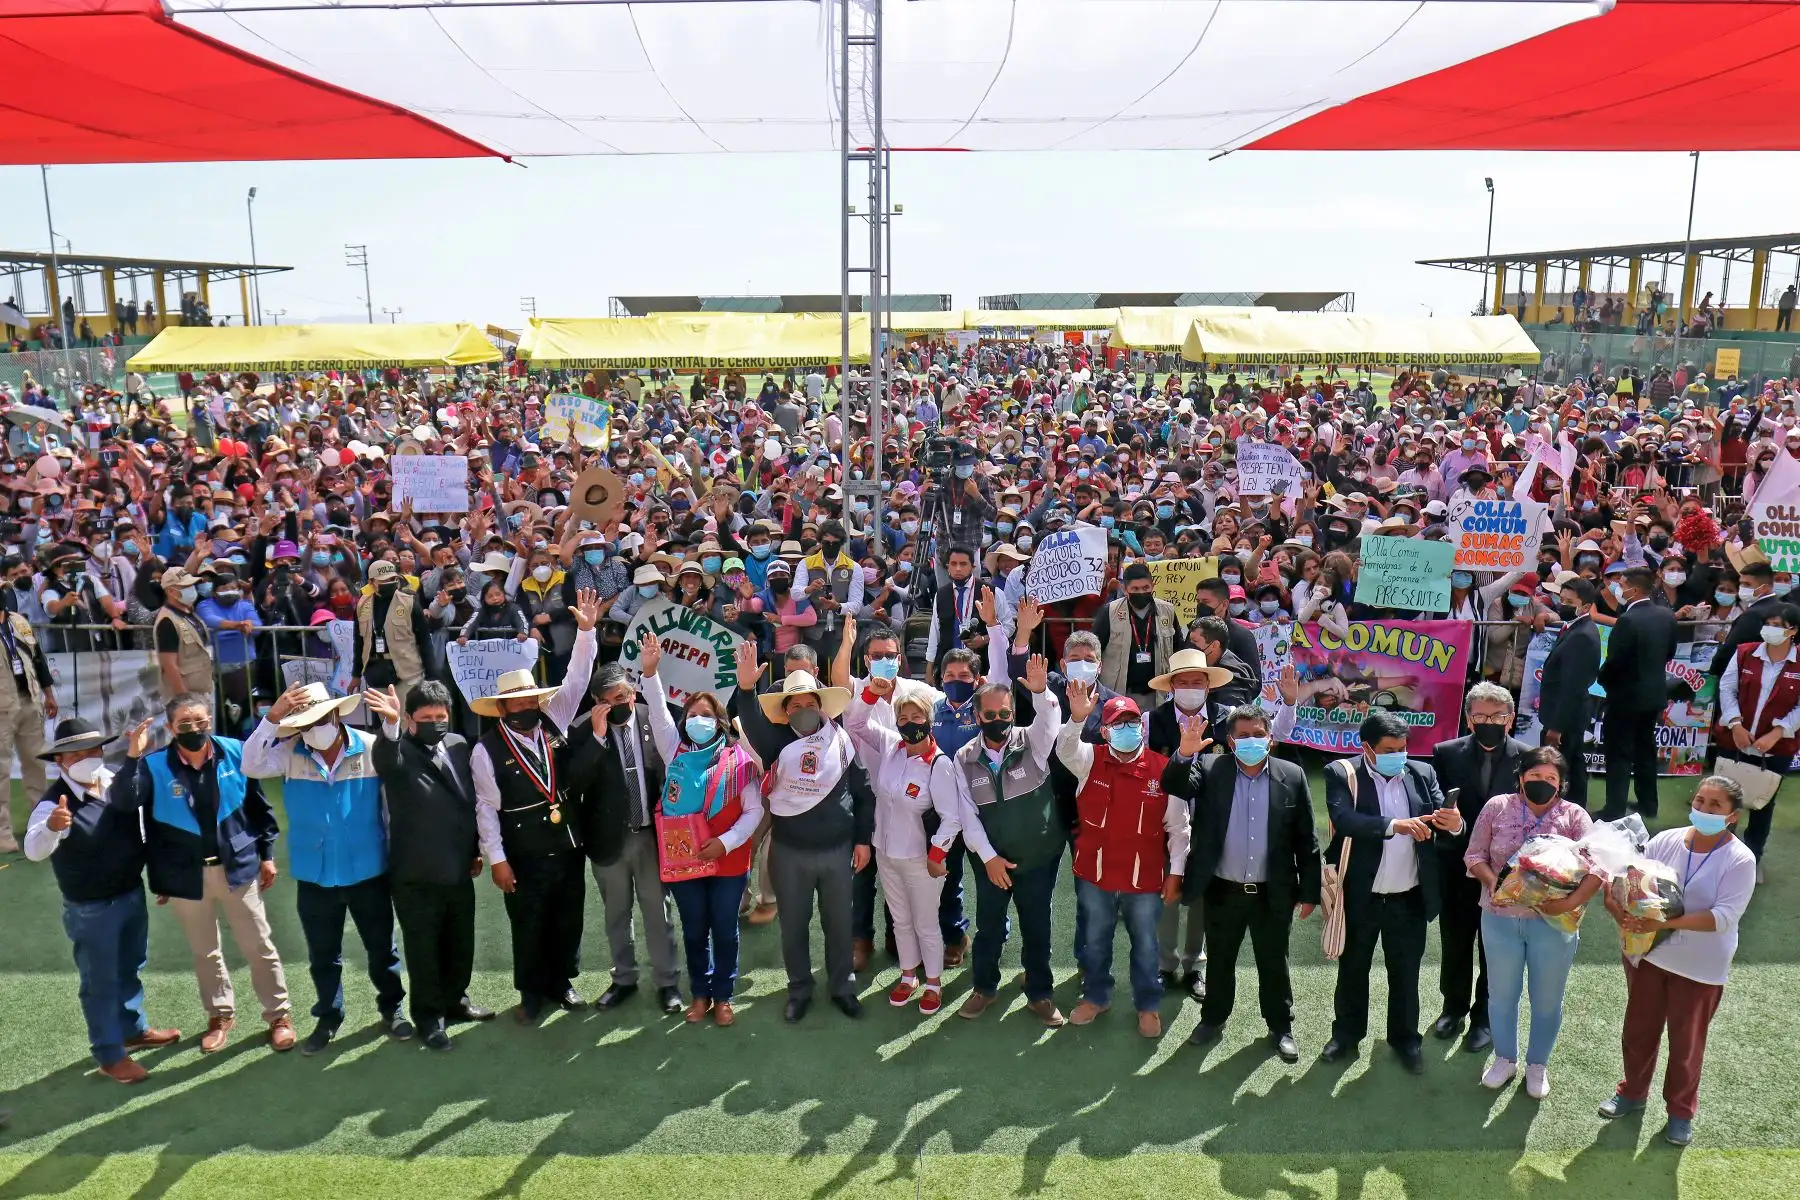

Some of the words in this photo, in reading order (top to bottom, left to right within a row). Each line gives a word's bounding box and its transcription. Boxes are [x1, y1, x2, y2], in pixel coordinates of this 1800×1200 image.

[150, 363, 231, 373] MUNICIPALIDAD
[234, 361, 288, 372] DISTRITAL
[291, 360, 305, 371] DE
[307, 360, 343, 371] CERRO
[346, 359, 405, 370] COLORADO
[560, 357, 646, 369] MUNICIPALIDAD
[649, 356, 707, 368] DISTRITAL
[710, 356, 724, 368] DE
[727, 356, 766, 367] CERRO
[768, 356, 829, 367] COLORADO
[1235, 353, 1322, 364] MUNICIPALIDAD
[1325, 352, 1381, 364] DISTRITAL
[1385, 352, 1400, 364] DE
[1403, 352, 1440, 364] CERRO
[1443, 352, 1503, 364] COLORADO
[1241, 462, 1284, 475] RESPETEN
[1289, 466, 1301, 477] LA
[1474, 501, 1522, 519] OLLA
[1766, 505, 1800, 521] OLL
[1462, 516, 1528, 535] COMUN
[1758, 521, 1800, 539] COMU
[1039, 530, 1081, 552] OLLA
[1367, 536, 1388, 558] Olla
[1461, 533, 1524, 551] SUMAC
[1759, 538, 1800, 556] AUTO
[1166, 561, 1201, 572] COMUN
[1409, 561, 1417, 572] de
[1424, 560, 1433, 573] la
[1455, 549, 1525, 568] SONCCO
[1027, 560, 1081, 588] GRUPO
[1084, 557, 1103, 573] 32
[1166, 574, 1186, 584] REY
[1028, 579, 1085, 602] CRISTO
[1375, 584, 1447, 608] PRESENTE
[450, 641, 522, 655] PERSONAS
[660, 637, 711, 669] APIPA
[1318, 622, 1456, 674] COMUN
[457, 655, 484, 667] CON
[455, 668, 505, 683] DISCAP
[1665, 660, 1706, 692] RIOSAS
[469, 684, 499, 700] PRE
[668, 684, 693, 705] VI
[1296, 705, 1326, 721] oras
[1329, 708, 1347, 723] de
[1350, 708, 1363, 724] la
[1328, 730, 1338, 747] V
[1342, 731, 1363, 749] PO
